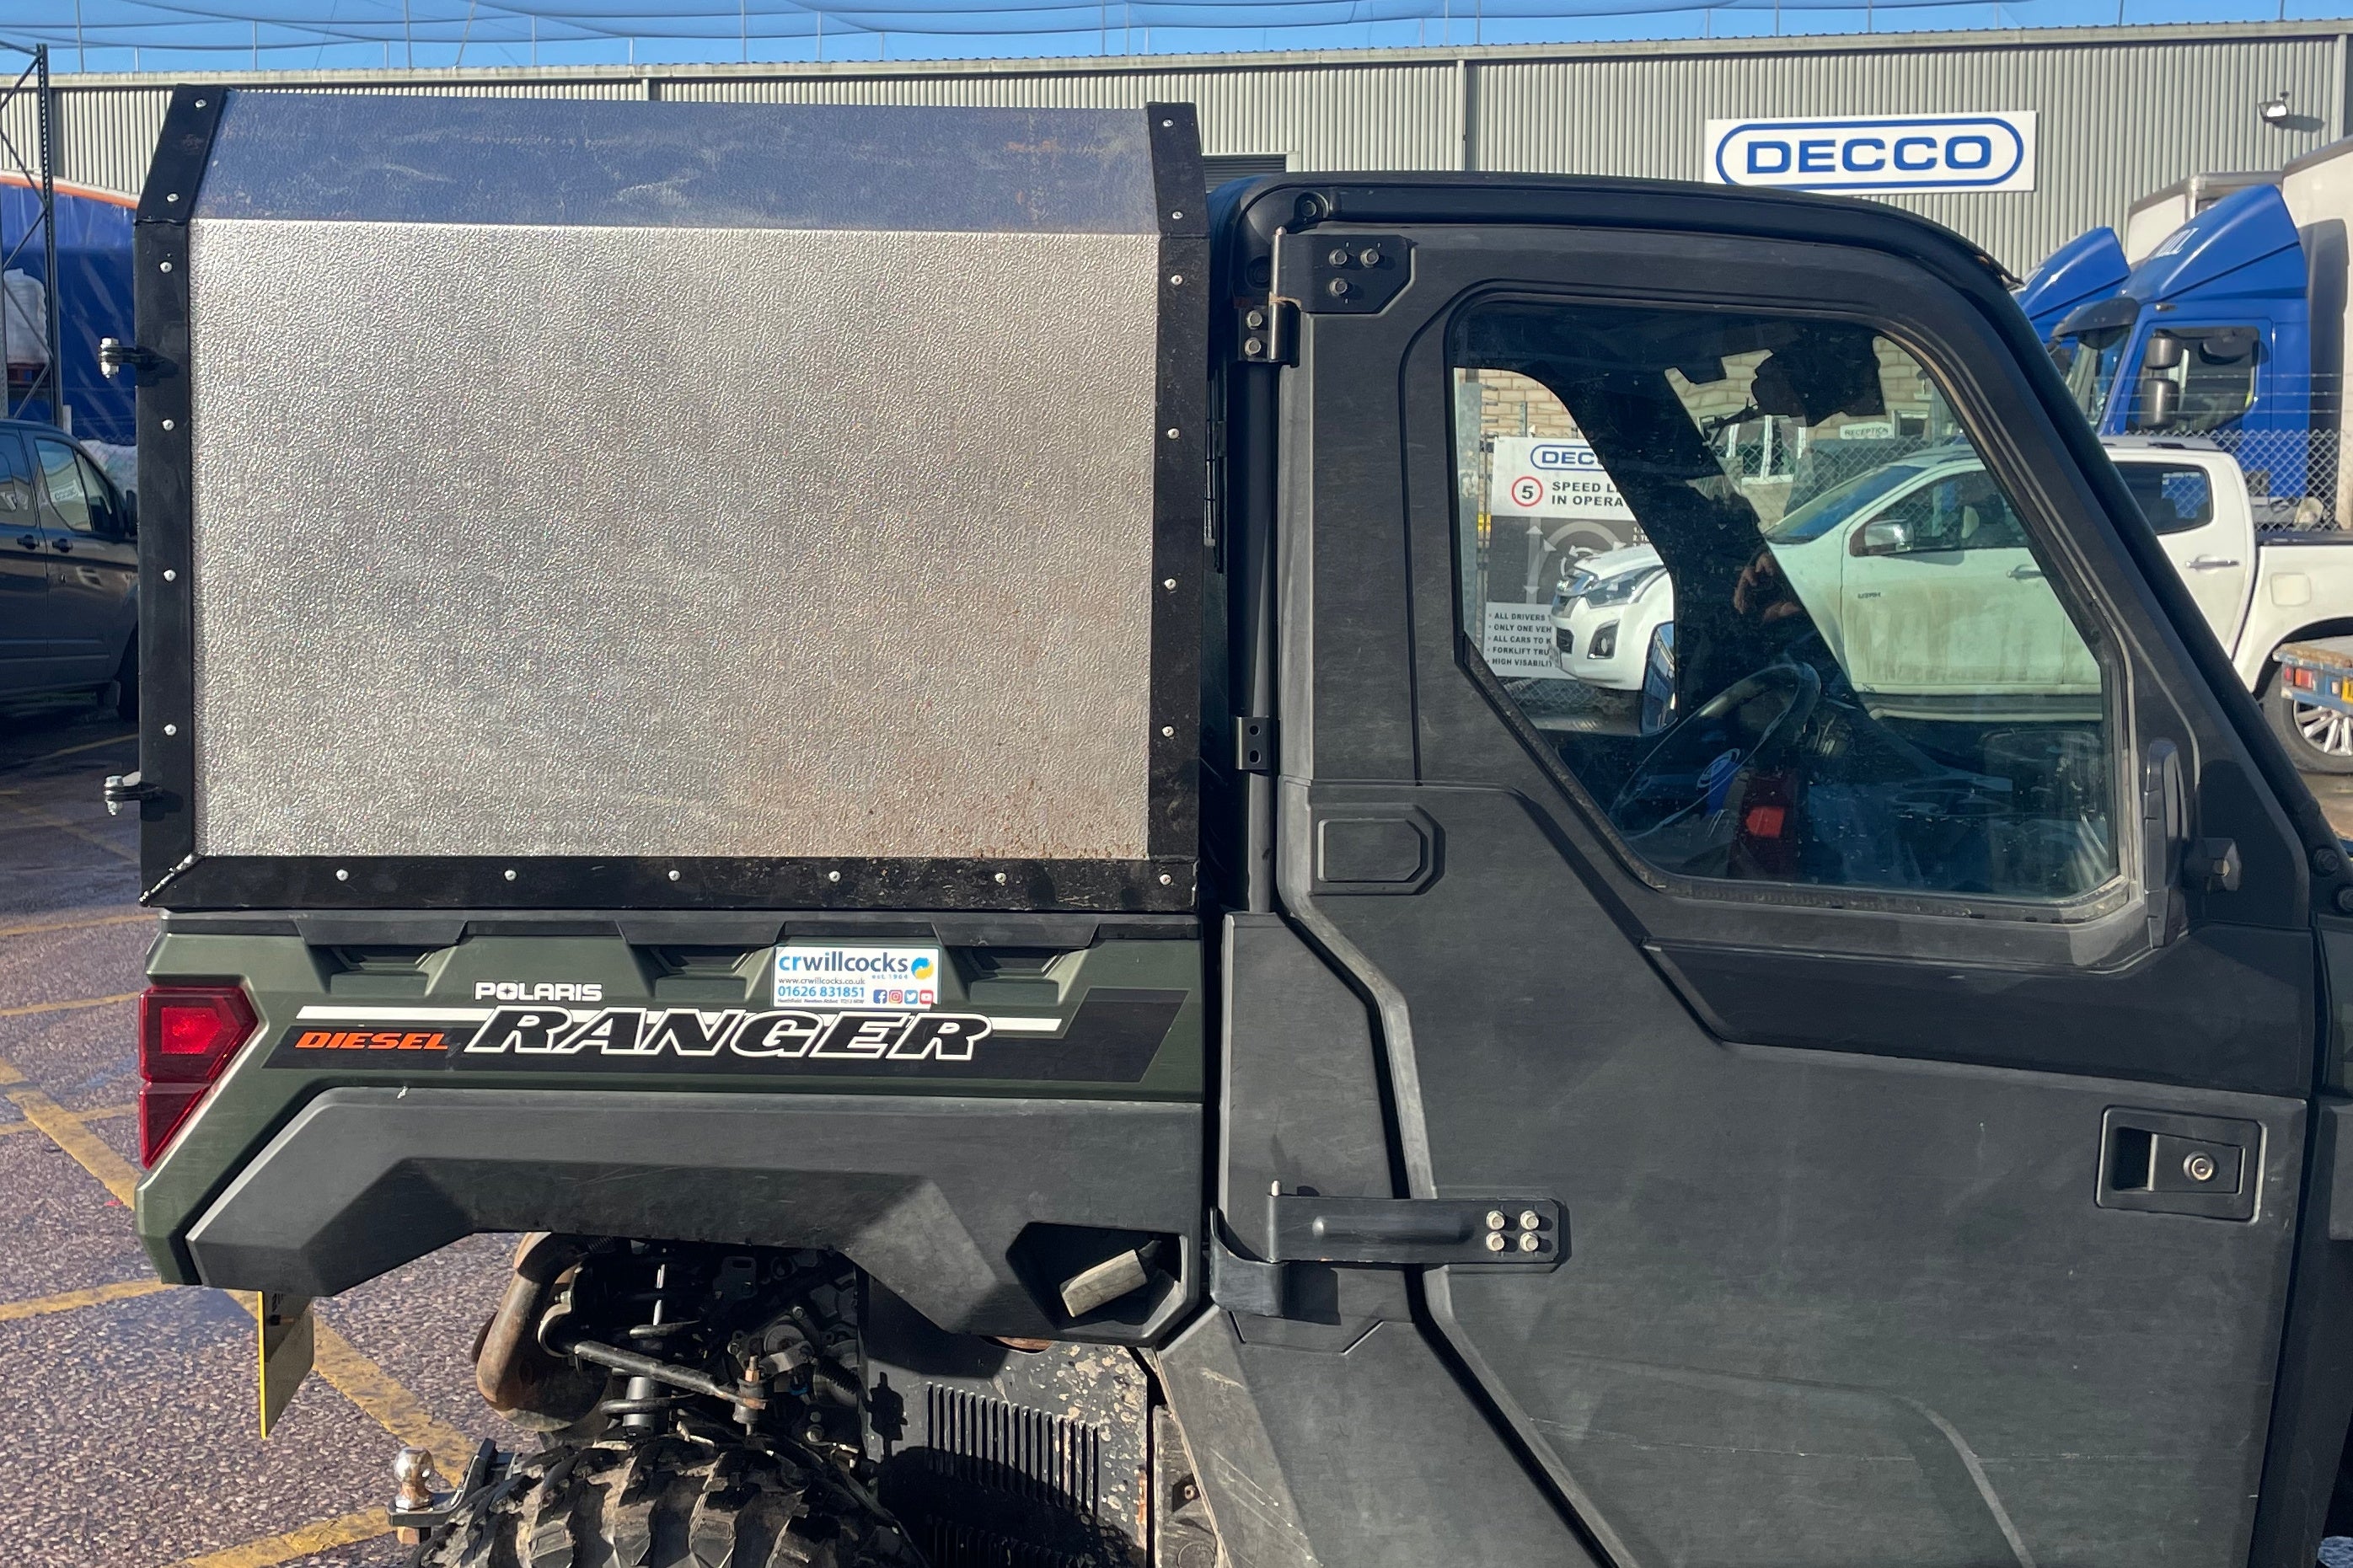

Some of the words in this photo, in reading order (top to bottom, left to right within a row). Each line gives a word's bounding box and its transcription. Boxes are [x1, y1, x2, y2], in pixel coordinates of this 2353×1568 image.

[1747, 136, 1991, 174] DECCO
[1542, 451, 1600, 464] DEC
[1521, 485, 1534, 500] 5
[1552, 481, 1601, 492] SPEED
[1552, 495, 1567, 505] IN
[1573, 495, 1624, 506] OPERA
[779, 951, 909, 972] crwillcocks
[474, 982, 602, 1002] POLARIS
[778, 986, 817, 997] 01626
[820, 986, 865, 998] 831851
[295, 1031, 448, 1050] DIESEL
[464, 1005, 993, 1060] RANGER
